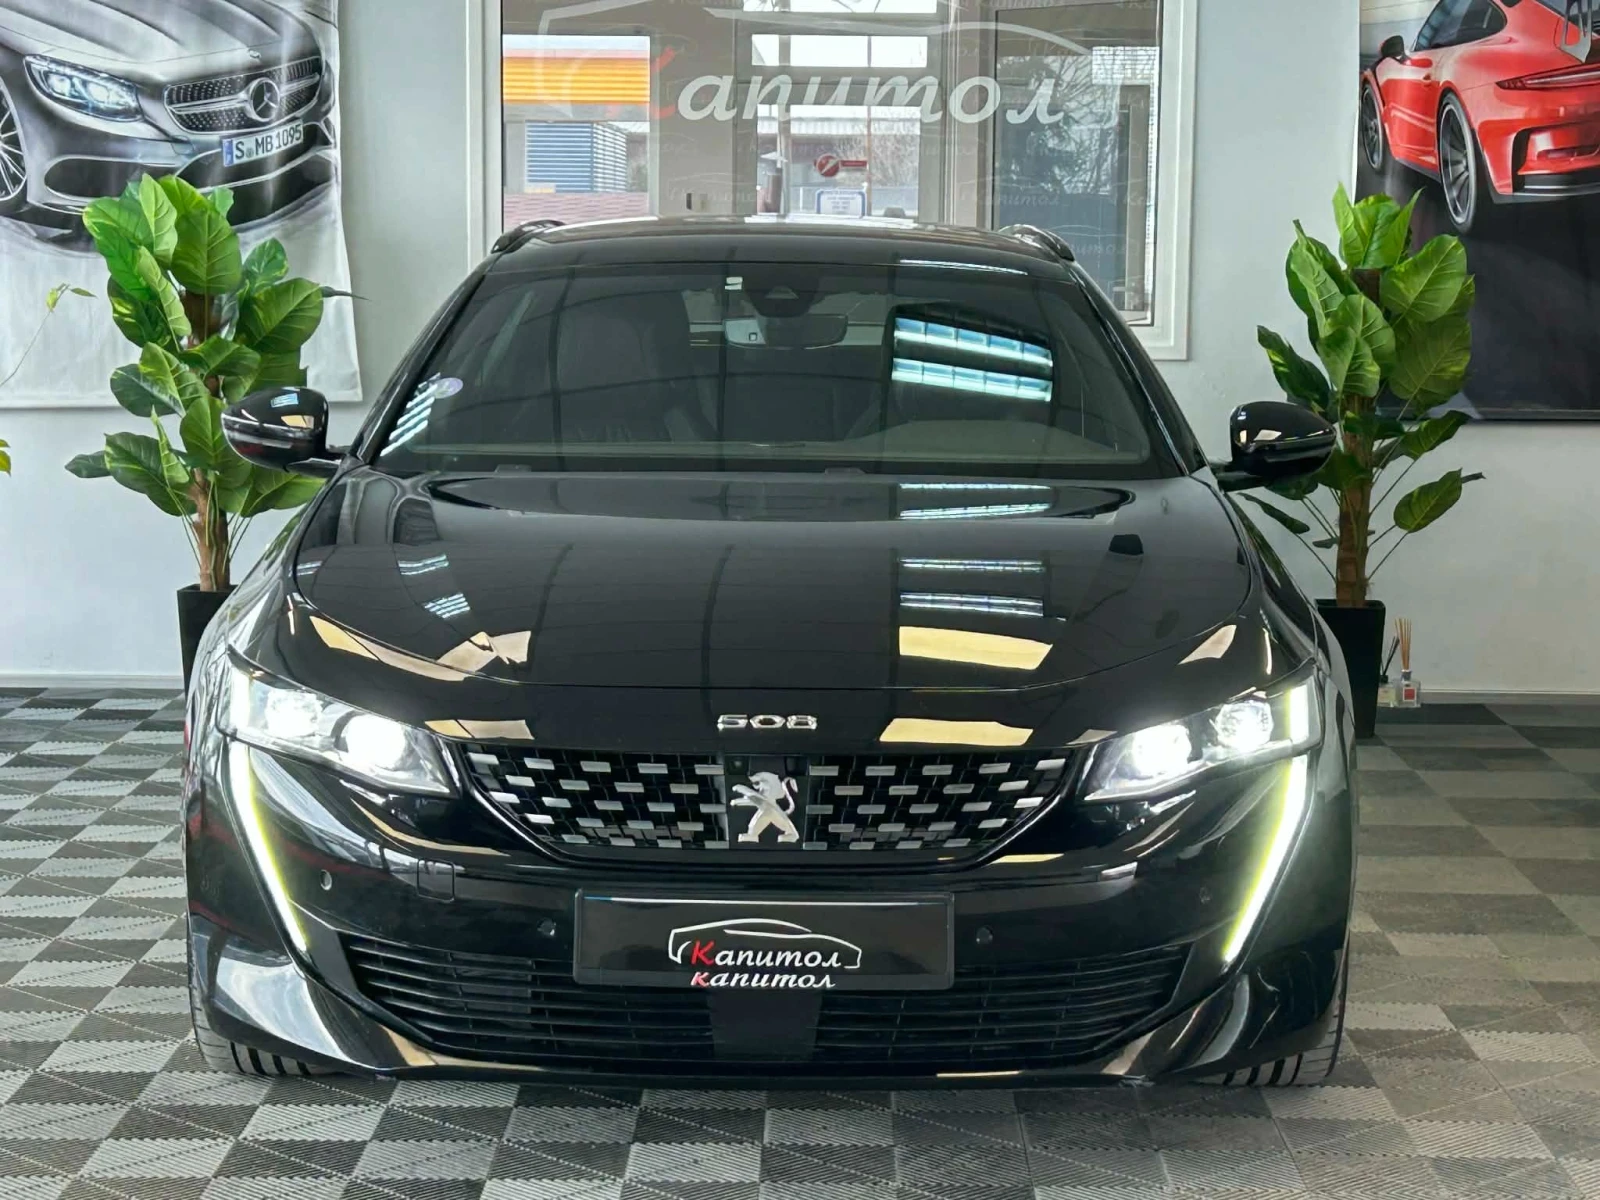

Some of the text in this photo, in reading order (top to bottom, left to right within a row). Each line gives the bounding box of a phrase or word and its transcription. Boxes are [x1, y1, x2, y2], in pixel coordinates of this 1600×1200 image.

[235, 124, 302, 160] S MB 1095
[717, 714, 818, 730] 508
[690, 938, 842, 968] Капитол
